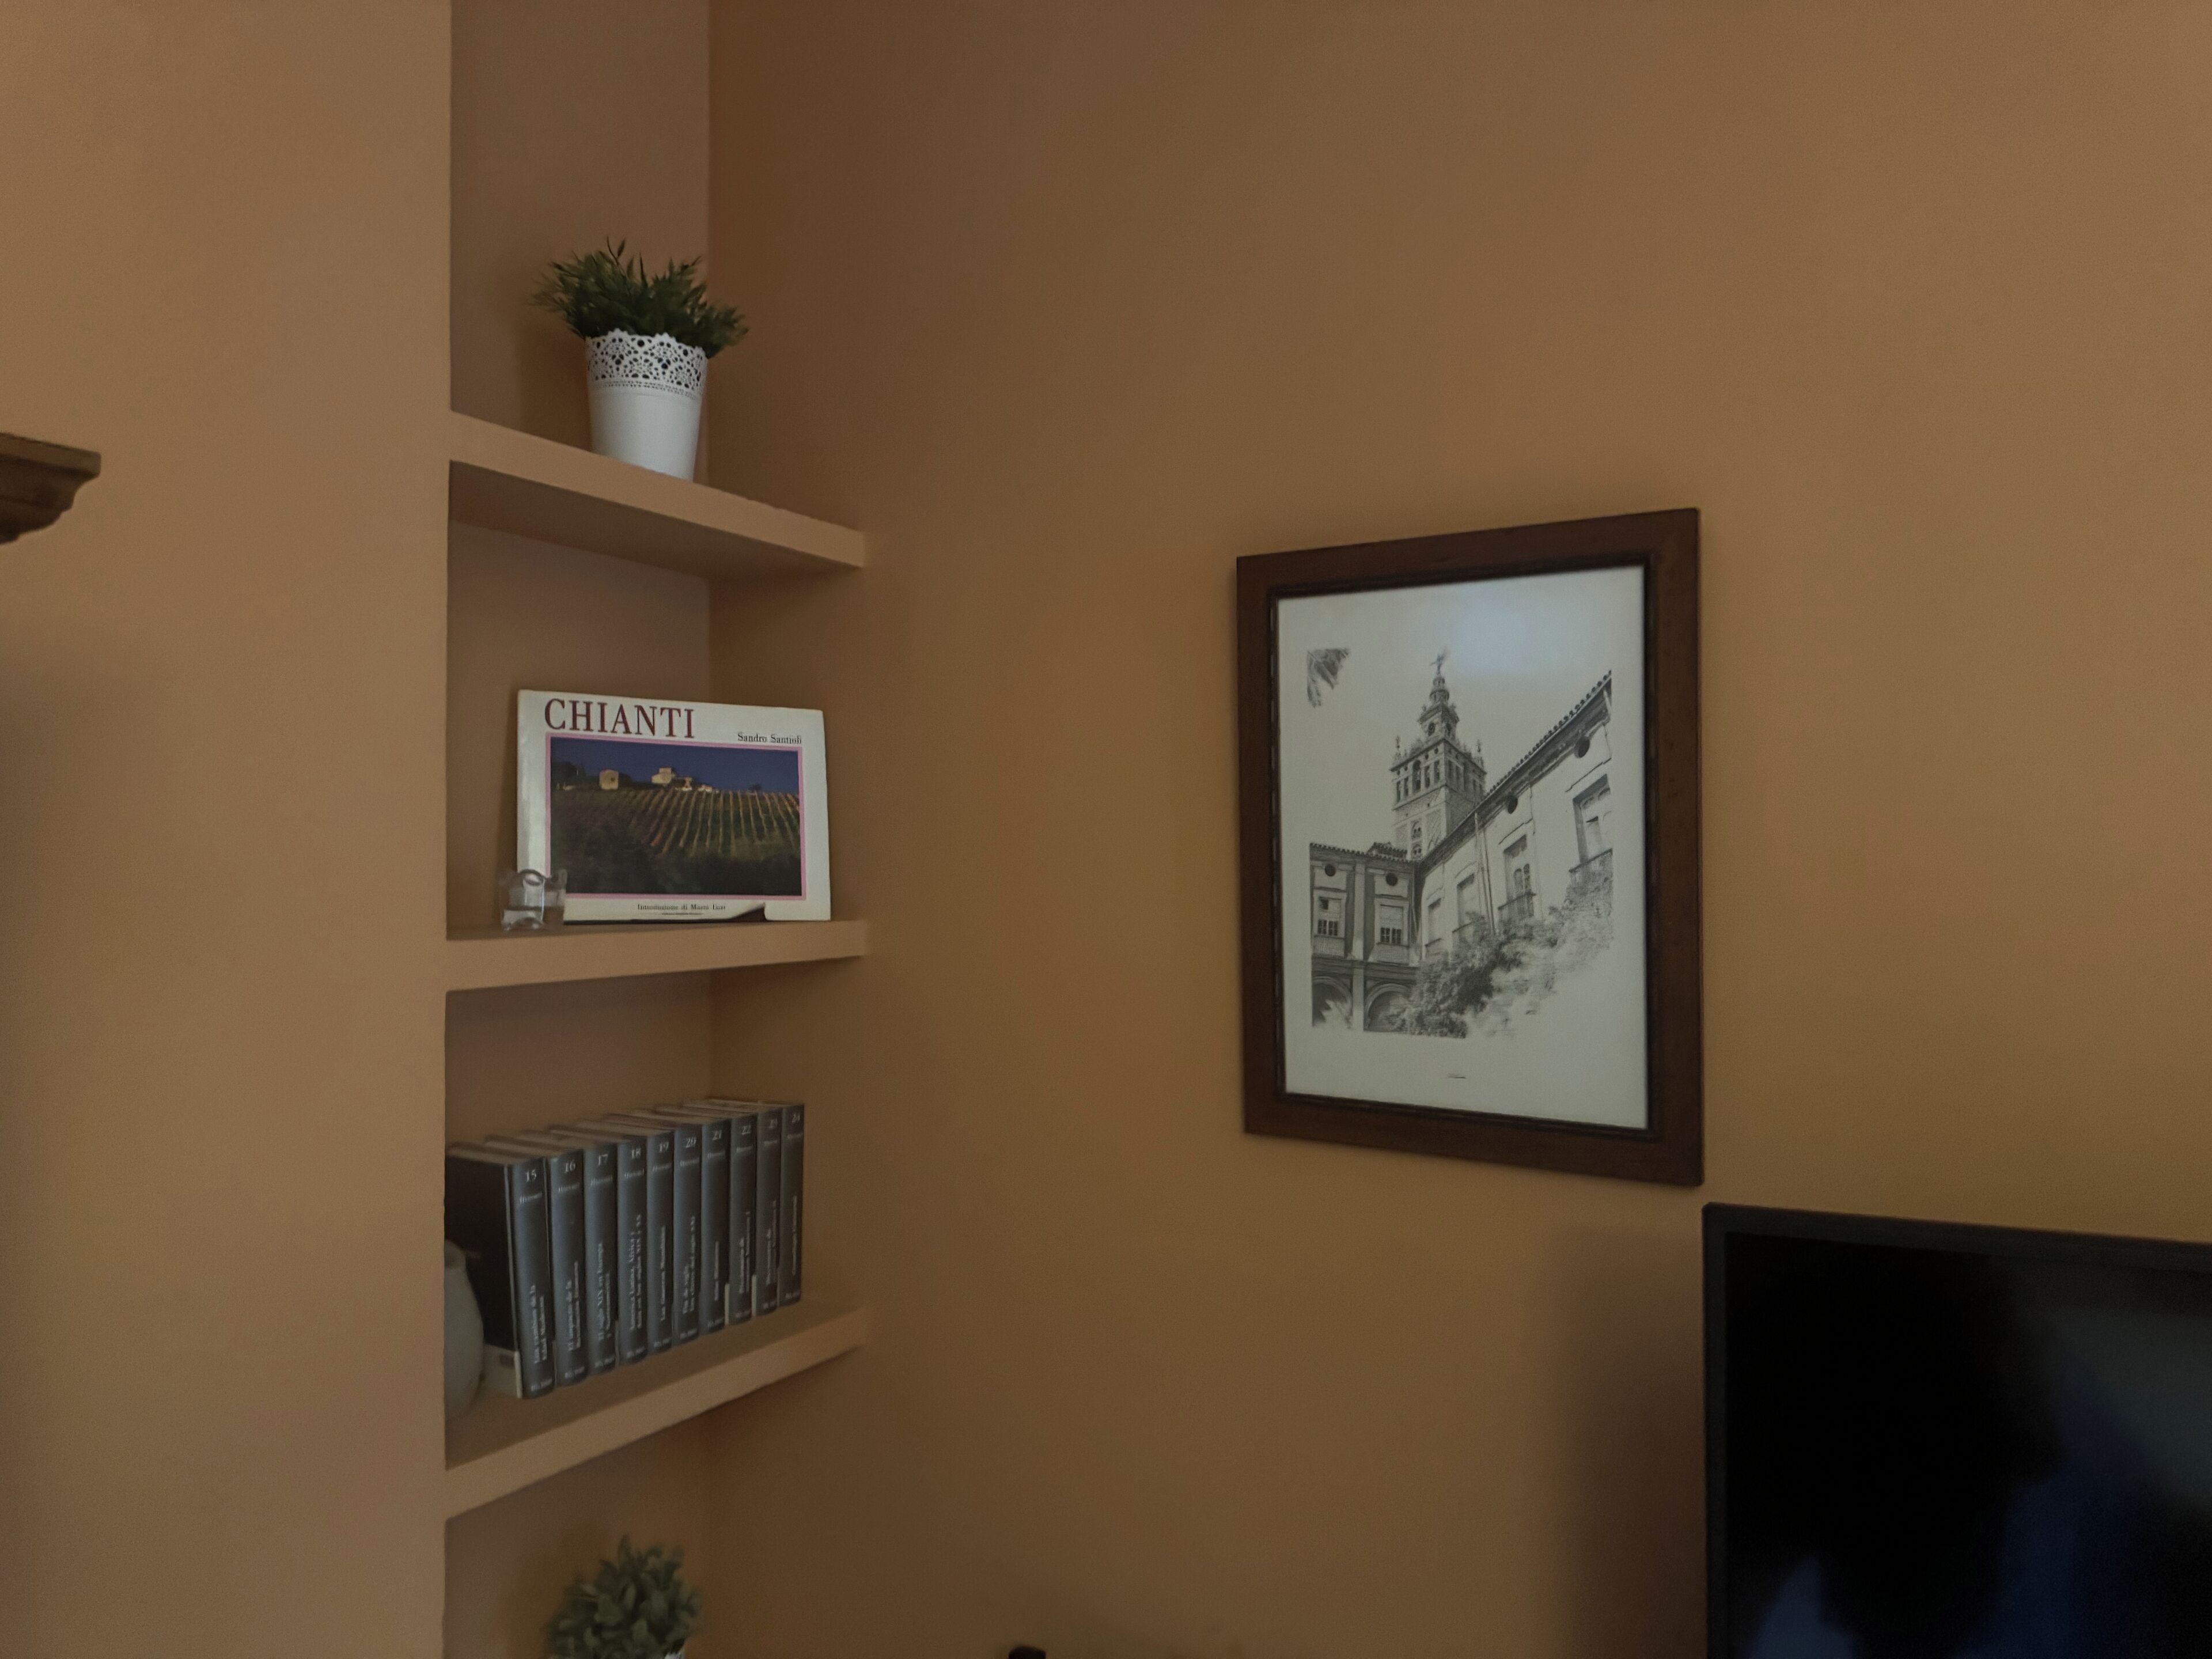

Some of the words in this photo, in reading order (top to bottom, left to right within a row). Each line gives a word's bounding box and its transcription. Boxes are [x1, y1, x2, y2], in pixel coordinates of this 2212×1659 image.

[545, 699, 694, 738] CHIANTI
[738, 732, 767, 743] Sandro
[771, 734, 802, 744] Santioli
[712, 1129, 724, 1141] 21
[741, 1124, 751, 1135] 22
[658, 1141, 669, 1154] 19
[685, 1136, 697, 1148] 20
[597, 1153, 609, 1166] 17
[631, 1147, 642, 1160] 18
[564, 1160, 577, 1173] 16
[525, 1169, 537, 1183] 15
